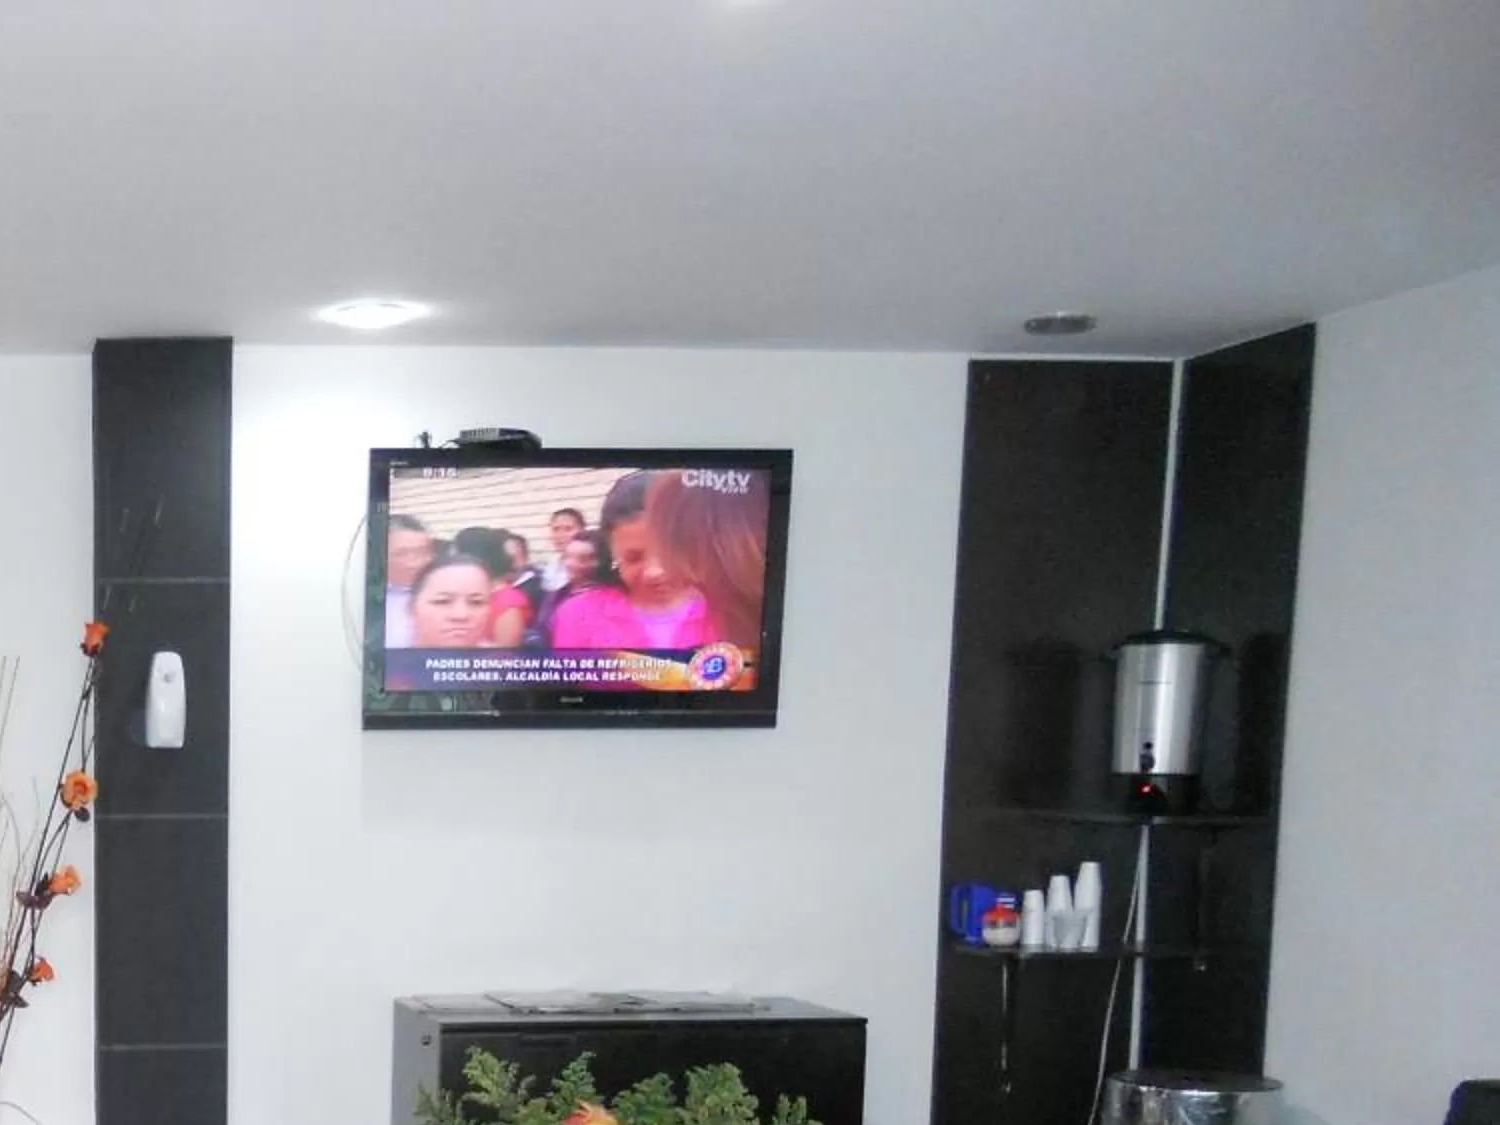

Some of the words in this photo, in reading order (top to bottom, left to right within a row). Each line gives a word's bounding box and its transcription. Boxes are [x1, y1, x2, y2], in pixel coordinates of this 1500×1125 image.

[425, 658, 471, 669] PADRES
[473, 659, 540, 669] DENUNCIAN
[543, 659, 577, 669] FALTA
[580, 659, 595, 669] DE
[505, 669, 561, 681] ALCALDÍA
[563, 671, 599, 681] LOCAL
